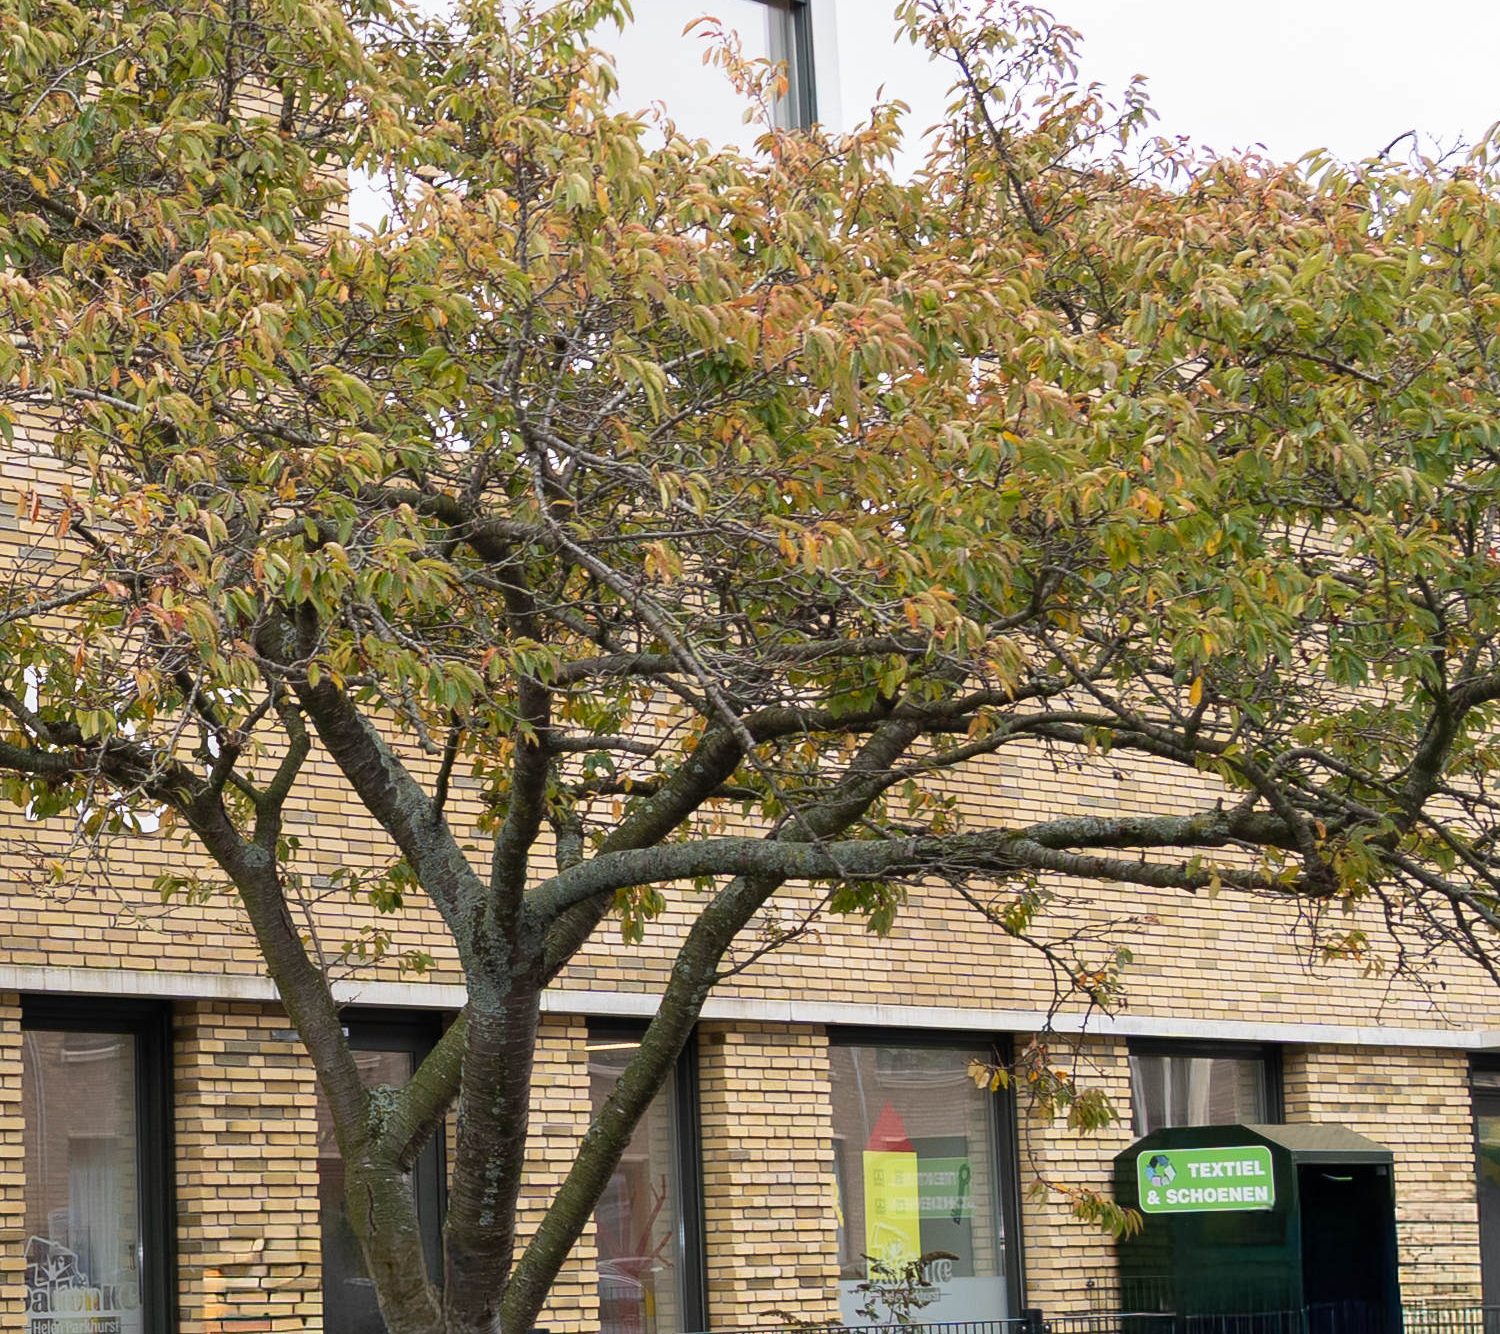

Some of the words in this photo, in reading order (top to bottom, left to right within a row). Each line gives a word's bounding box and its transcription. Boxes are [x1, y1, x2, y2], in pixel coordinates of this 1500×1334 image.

[1187, 1160, 1266, 1178] TEXTIEL
[1146, 1189, 1161, 1205] &
[1165, 1186, 1268, 1205] SCHOENEN
[65, 1318, 120, 1334] Parkhurst
